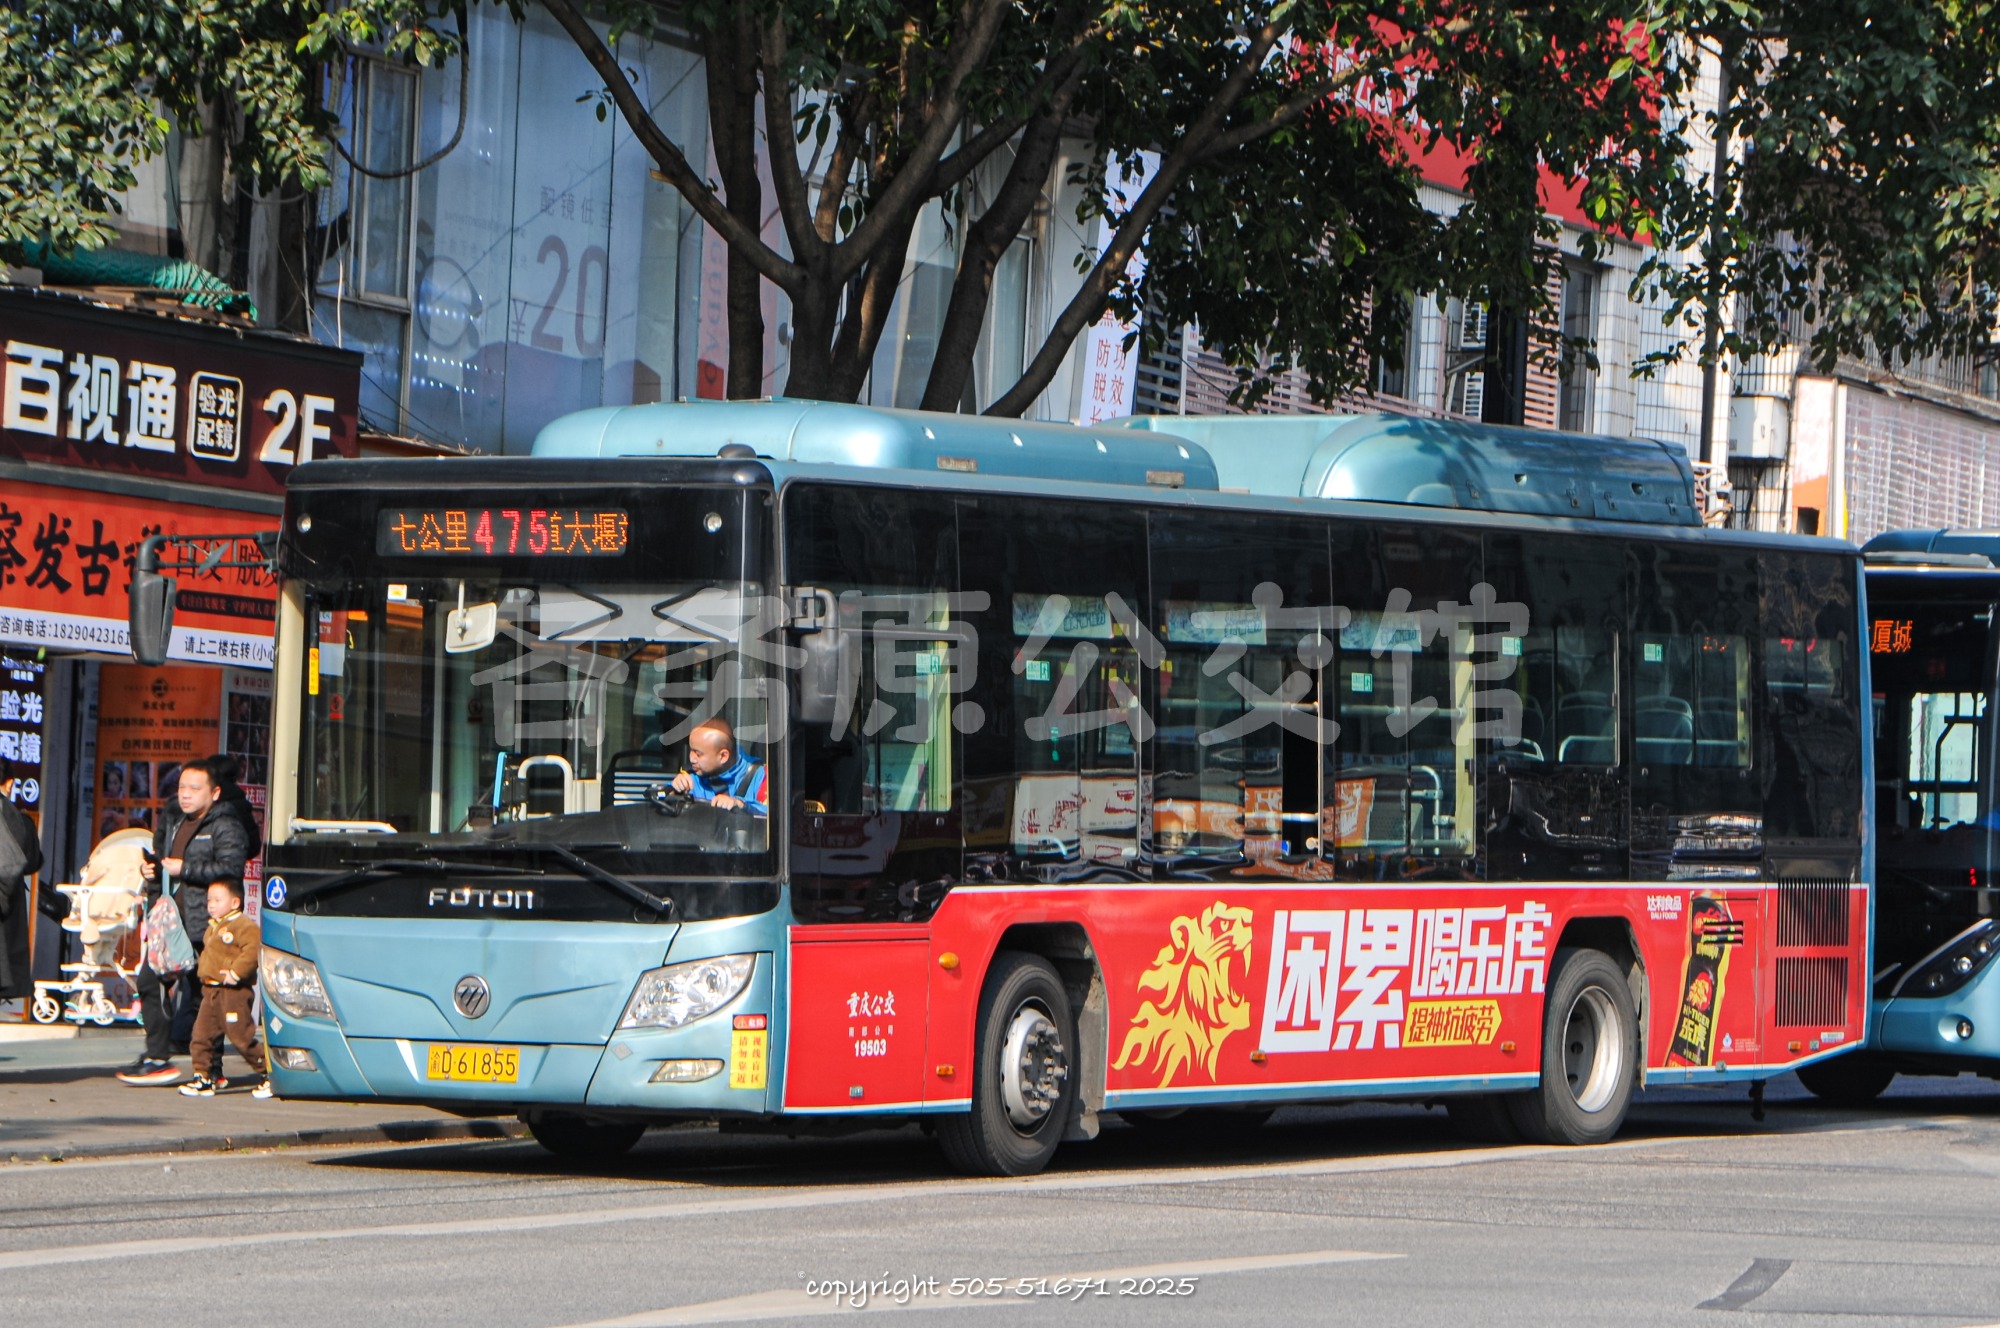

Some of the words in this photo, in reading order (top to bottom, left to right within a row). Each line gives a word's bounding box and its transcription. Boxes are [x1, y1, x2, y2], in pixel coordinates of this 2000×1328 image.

[3, 340, 178, 454] 百视通
[199, 384, 236, 416] 验光
[196, 417, 235, 451] 配镜
[259, 388, 336, 466] 2F
[391, 512, 471, 552] 七公里
[475, 510, 548, 554] 475
[1868, 620, 1913, 653] 厦城
[0, 689, 43, 724] 验光
[0, 730, 42, 764] 配镜
[428, 886, 534, 910] FOTON
[1646, 894, 1682, 912] 达利食品
[846, 989, 896, 1018] 重庆公交
[1408, 1005, 1495, 1045] 提神抗疲劳
[854, 1038, 887, 1057] 19503
